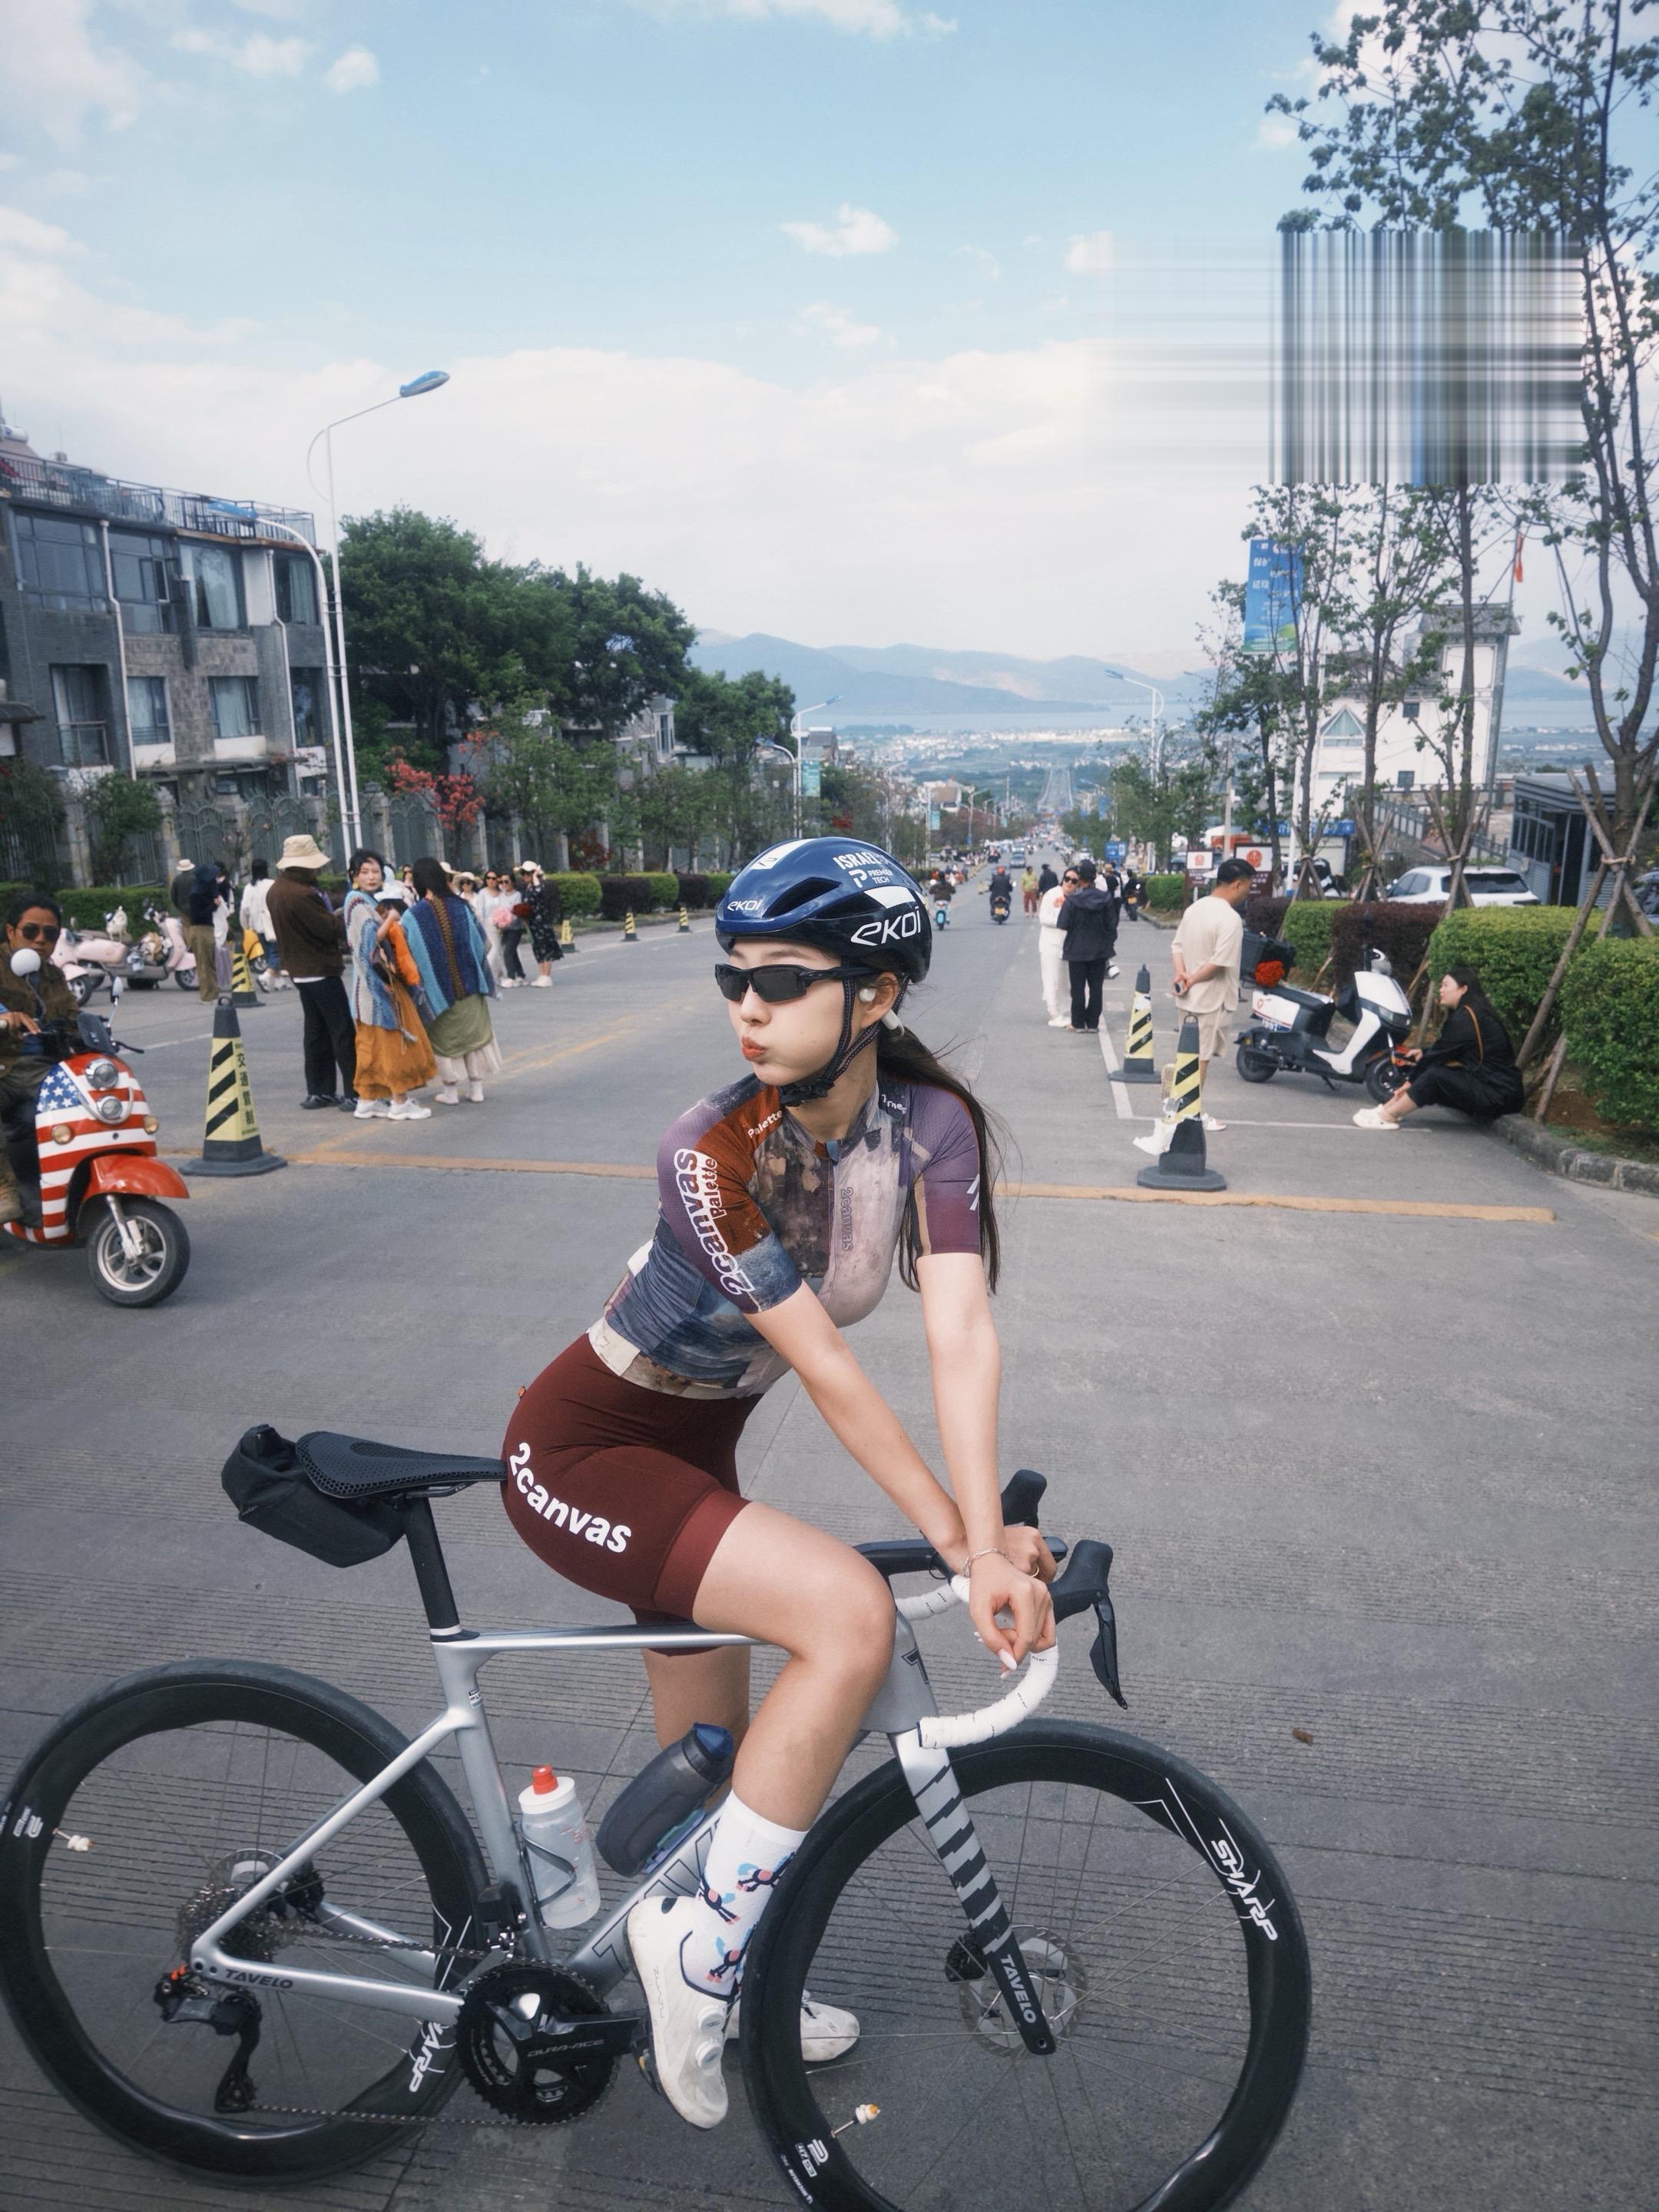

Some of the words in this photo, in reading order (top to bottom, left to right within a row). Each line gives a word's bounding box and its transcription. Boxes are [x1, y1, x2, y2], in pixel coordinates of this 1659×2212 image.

[833, 852, 882, 870] ISRAEL
[867, 869, 894, 877] PREMIER
[674, 1148, 756, 1295] 2canvas
[841, 1187, 854, 1252] 2canvas
[509, 1442, 632, 1553] 2canvas
[1210, 1839, 1278, 1941] SHARP
[225, 1968, 293, 1989] TAVELO
[1001, 1953, 1037, 2024] TAVELO
